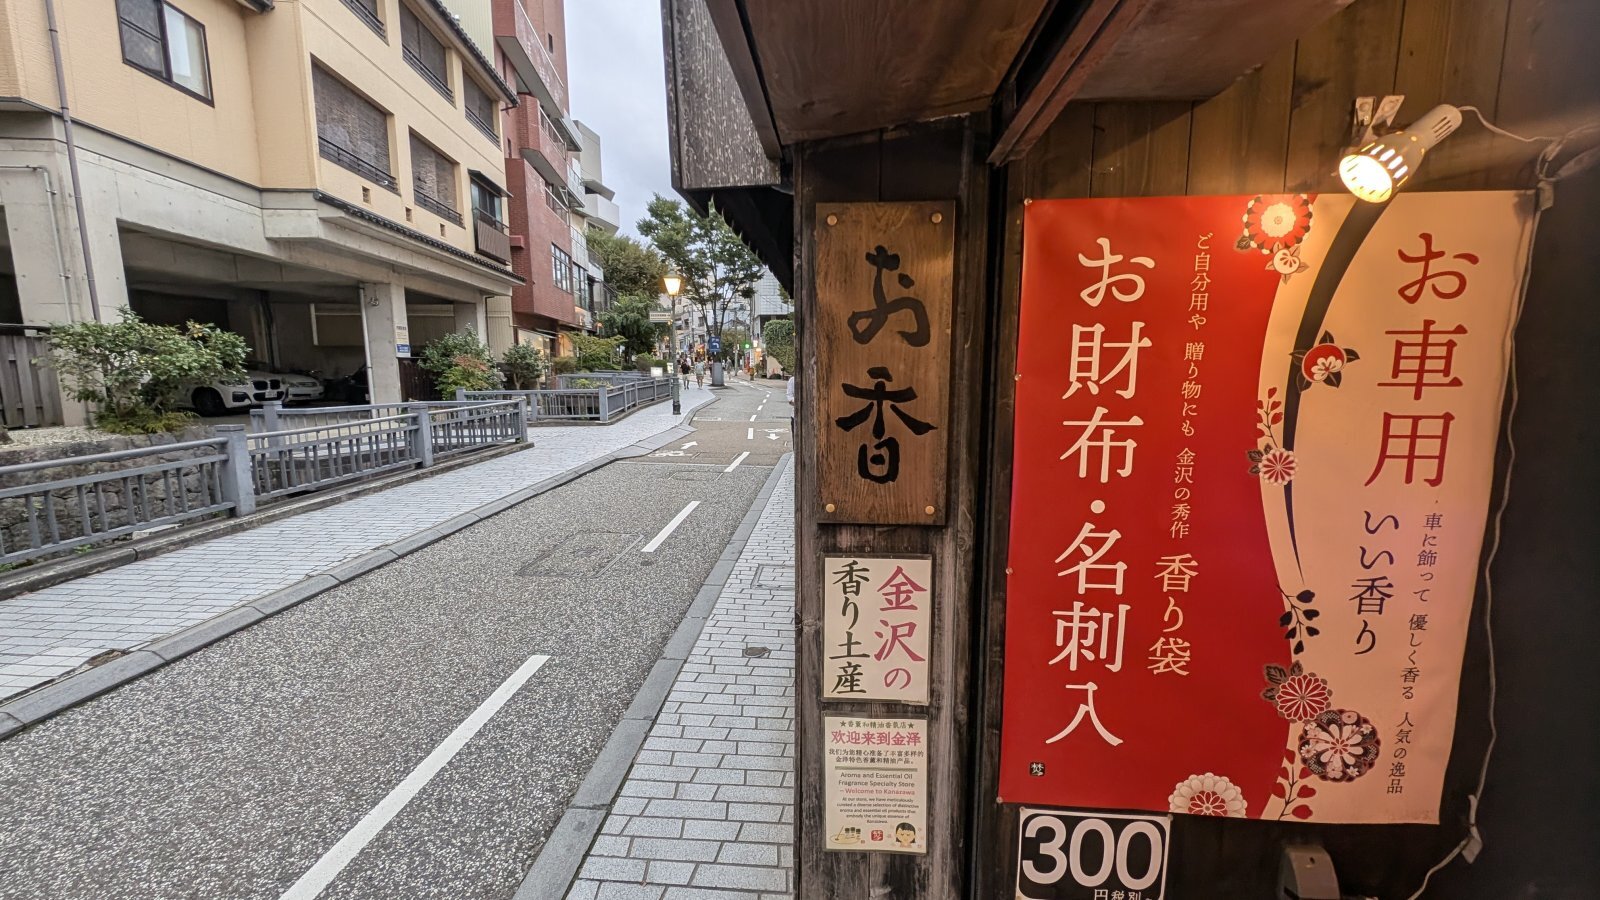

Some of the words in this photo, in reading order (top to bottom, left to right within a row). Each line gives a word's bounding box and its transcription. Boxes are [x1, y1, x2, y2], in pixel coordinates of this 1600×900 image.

[1188, 232, 1214, 330] ご自分用や
[834, 244, 938, 485] お香
[1181, 341, 1205, 437] 贈り物にも
[1364, 232, 1480, 488] お車用
[1045, 237, 1155, 747] お財布・名刺入
[1170, 447, 1196, 539] 金沢の秀作
[1348, 509, 1400, 655] いい香り
[1412, 512, 1443, 603] 車に飾って
[828, 559, 871, 695] 香り土産
[873, 565, 928, 690] 金沢の
[1147, 553, 1199, 676] 香り袋
[1400, 613, 1429, 700] 優しく香る
[831, 730, 921, 746] 欢迎来到金泽
[1386, 711, 1415, 795] 人気の逸品
[1022, 815, 1163, 890] 300
